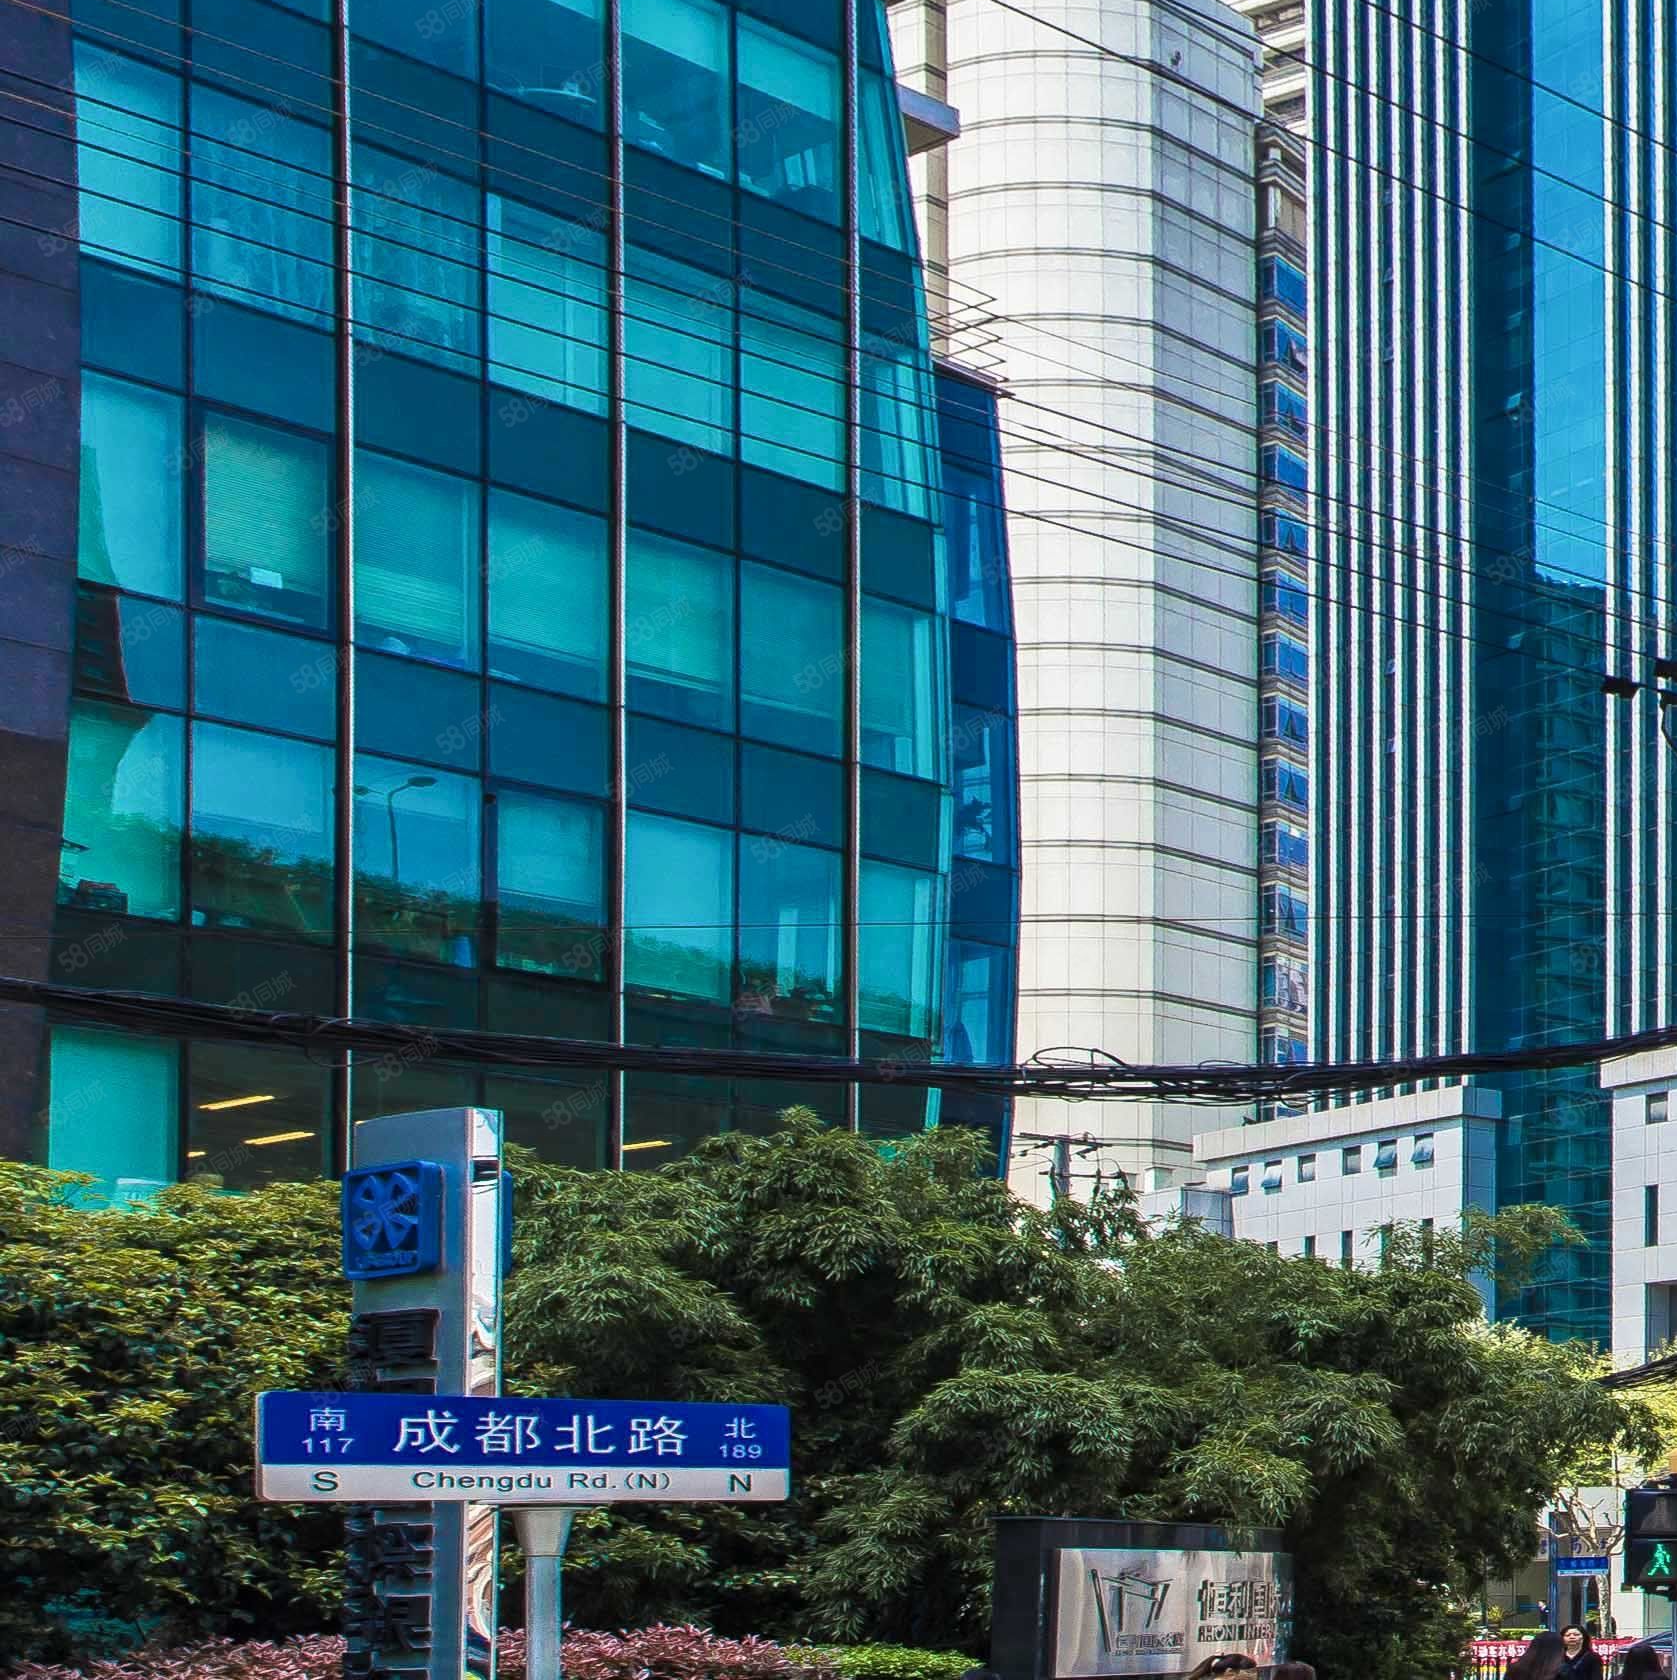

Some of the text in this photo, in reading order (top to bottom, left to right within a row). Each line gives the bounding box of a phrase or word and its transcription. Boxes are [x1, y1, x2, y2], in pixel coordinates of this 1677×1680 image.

[310, 1407, 347, 1432] 南
[725, 1417, 756, 1438] 北
[392, 1409, 688, 1456] 成都北路
[302, 1437, 353, 1454] 117
[719, 1444, 763, 1459] 189
[312, 1471, 339, 1491] S
[413, 1470, 553, 1492] Chengdu
[729, 1474, 752, 1493] N
